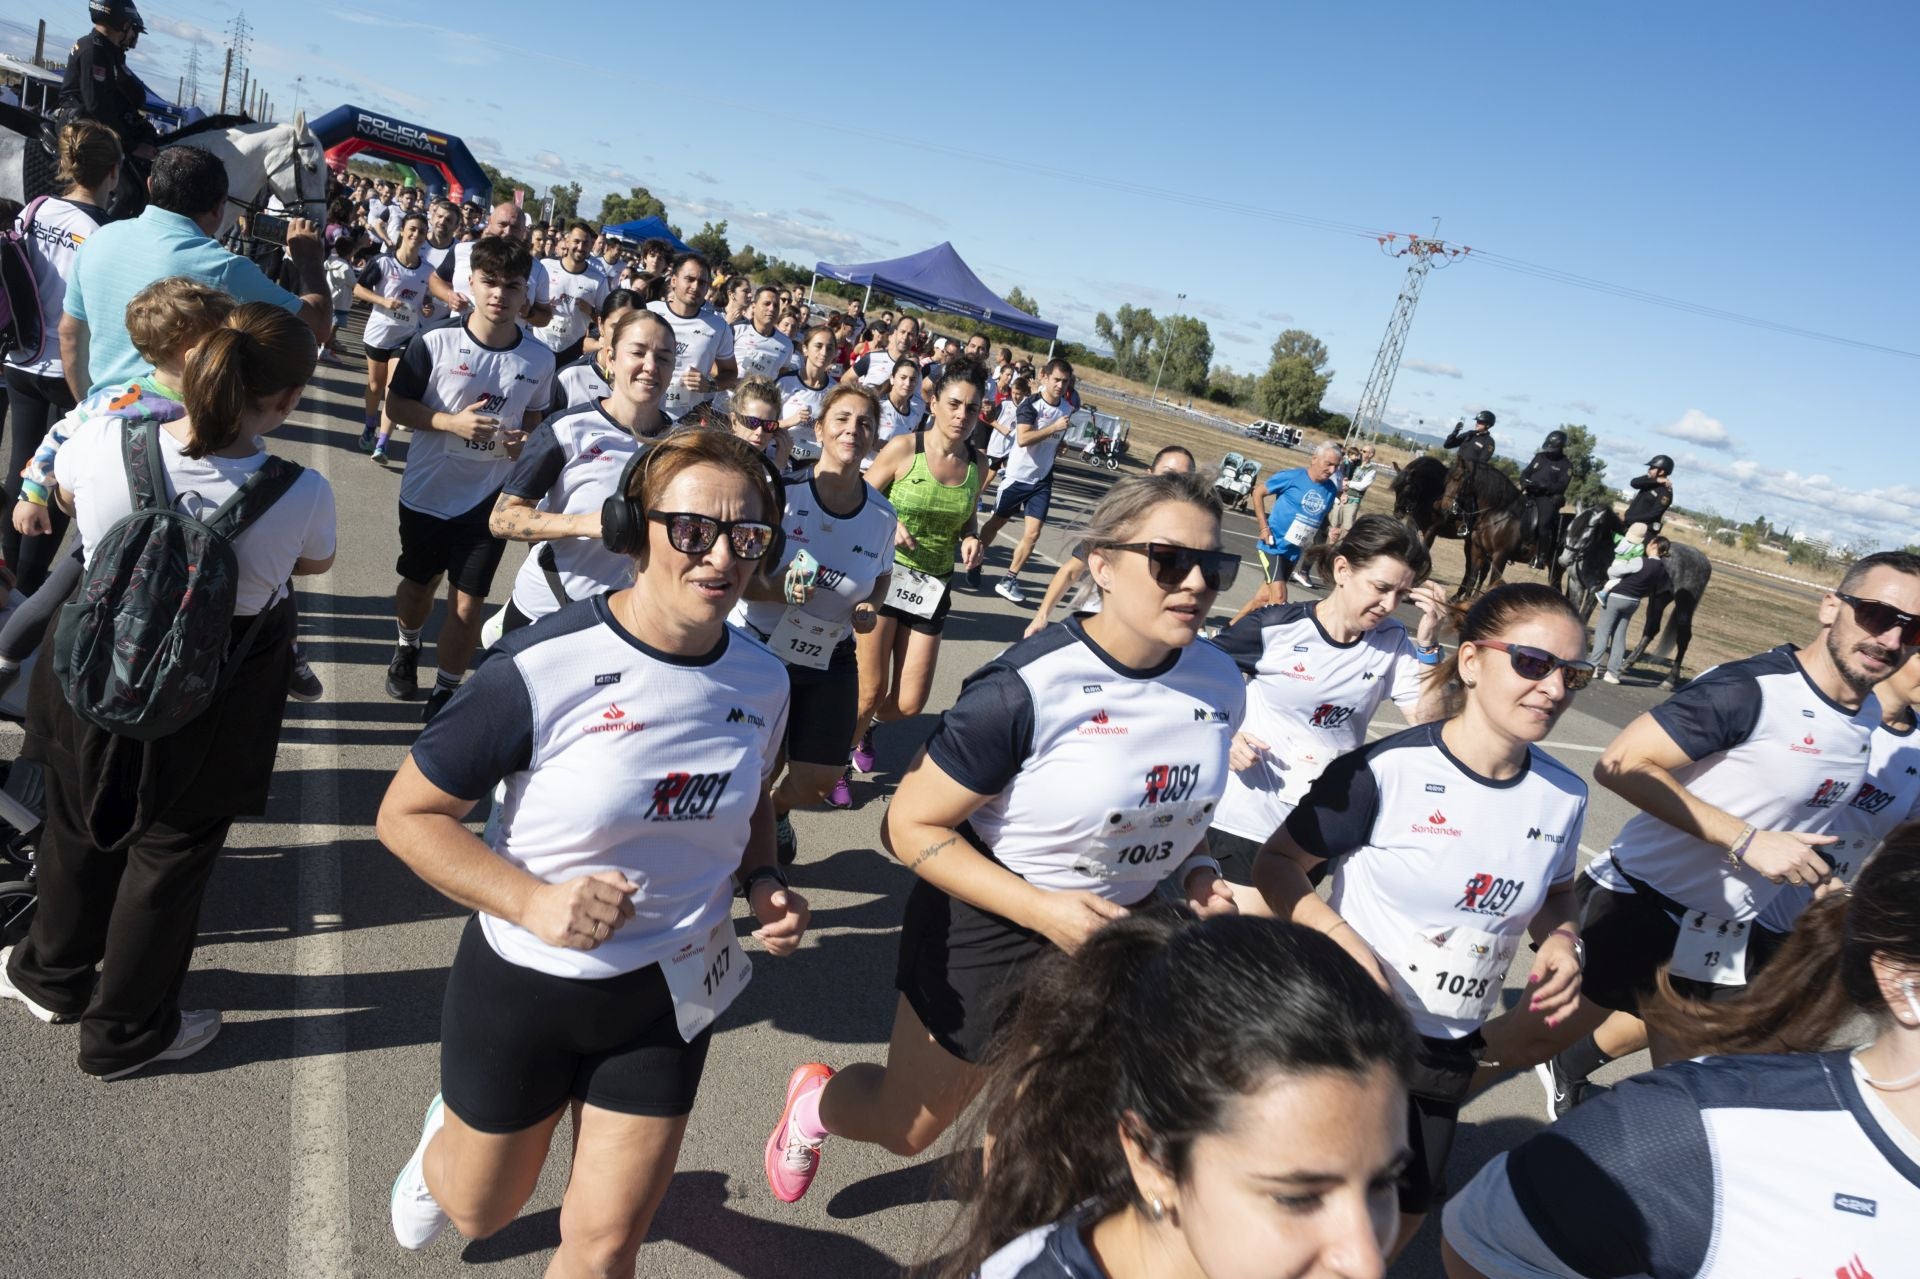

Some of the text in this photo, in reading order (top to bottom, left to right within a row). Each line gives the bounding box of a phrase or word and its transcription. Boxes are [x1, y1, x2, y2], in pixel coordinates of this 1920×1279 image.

[357, 113, 429, 142] POLICIA
[356, 123, 446, 156] NACIONAL
[32, 219, 73, 241] OLICIA
[35, 230, 78, 252] CIONA
[664, 392, 681, 402] 234
[463, 439, 496, 452] 1530
[896, 588, 924, 605] 1580
[789, 637, 823, 657] 1372
[582, 720, 646, 734] Santander
[1076, 725, 1129, 736] Santander
[1410, 823, 1463, 838] Santander
[1116, 840, 1174, 865] 1003
[1434, 970, 1489, 999] 1028
